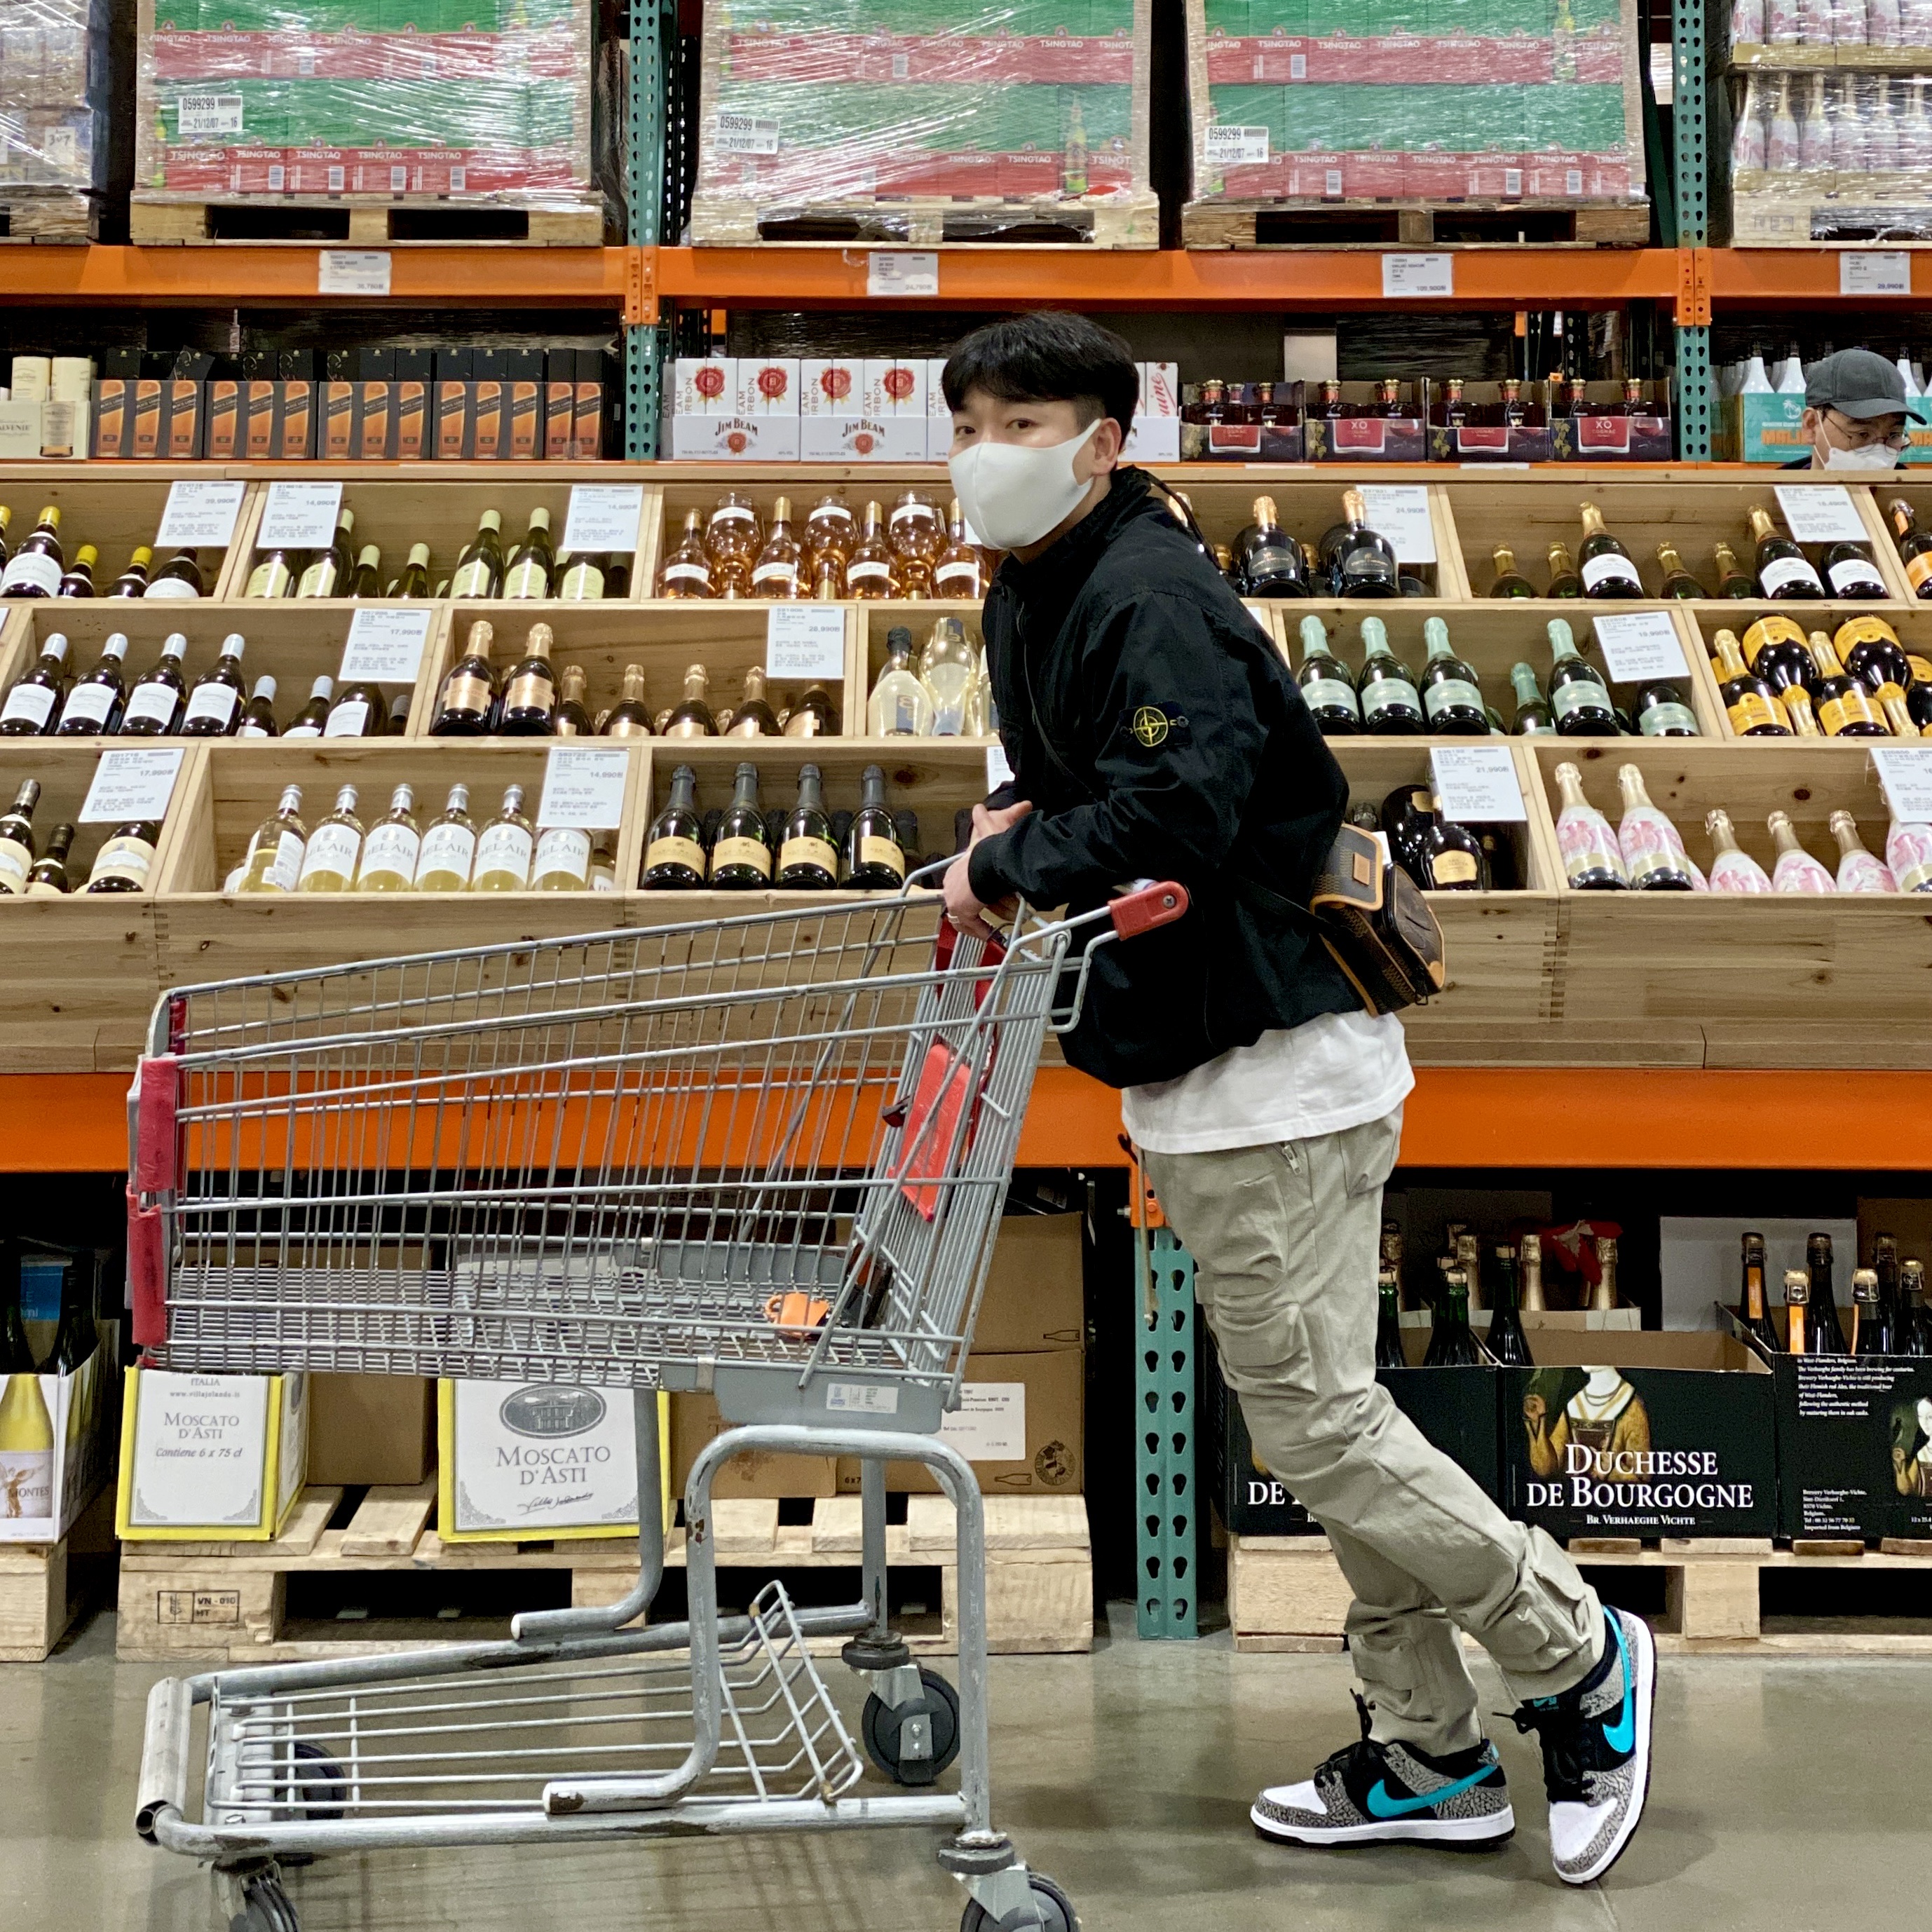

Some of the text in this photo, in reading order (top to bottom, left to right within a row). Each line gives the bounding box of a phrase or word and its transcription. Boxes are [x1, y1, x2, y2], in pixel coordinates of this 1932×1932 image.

[1040, 40, 1083, 48] TSINGTAO
[182, 97, 215, 110] 0599299
[193, 118, 219, 128] 21/12/07
[720, 116, 752, 131] 0599299
[1209, 128, 1241, 140] 0599299
[729, 137, 754, 149] 21/12/07
[236, 150, 280, 158] TSINGTAO
[296, 151, 340, 159] TSINGTAO
[358, 151, 402, 159] TSINGTAO
[417, 151, 461, 159] TSINGTAO
[1219, 148, 1245, 158] 21/12/07
[1092, 156, 1131, 164] TSINGT
[662, 394, 671, 419] EAM
[715, 418, 758, 436] JIM BEAM
[843, 419, 885, 437] JIM BEAM
[1351, 421, 1368, 429] XO
[1596, 421, 1612, 429] XO
[333, 843, 353, 857] AIR
[393, 843, 414, 859] AIR
[446, 843, 468, 858] AIR
[505, 843, 527, 858] AIR
[564, 844, 585, 859] AIR
[191, 1377, 220, 1386] ITALIA
[164, 1412, 240, 1426] MOSCATO
[156, 1448, 197, 1457] Contiene
[199, 1448, 206, 1457] 6
[218, 1448, 232, 1457] 75
[496, 1445, 611, 1468] MOSCATO
[1565, 1444, 1718, 1475] DUCHESSE
[1248, 1481, 1285, 1505] DE
[1527, 1476, 1753, 1508] DE BOURGOGNE
[1603, 1514, 1659, 1525] VERHAEGHE
[1662, 1514, 1696, 1525] VICHTE
